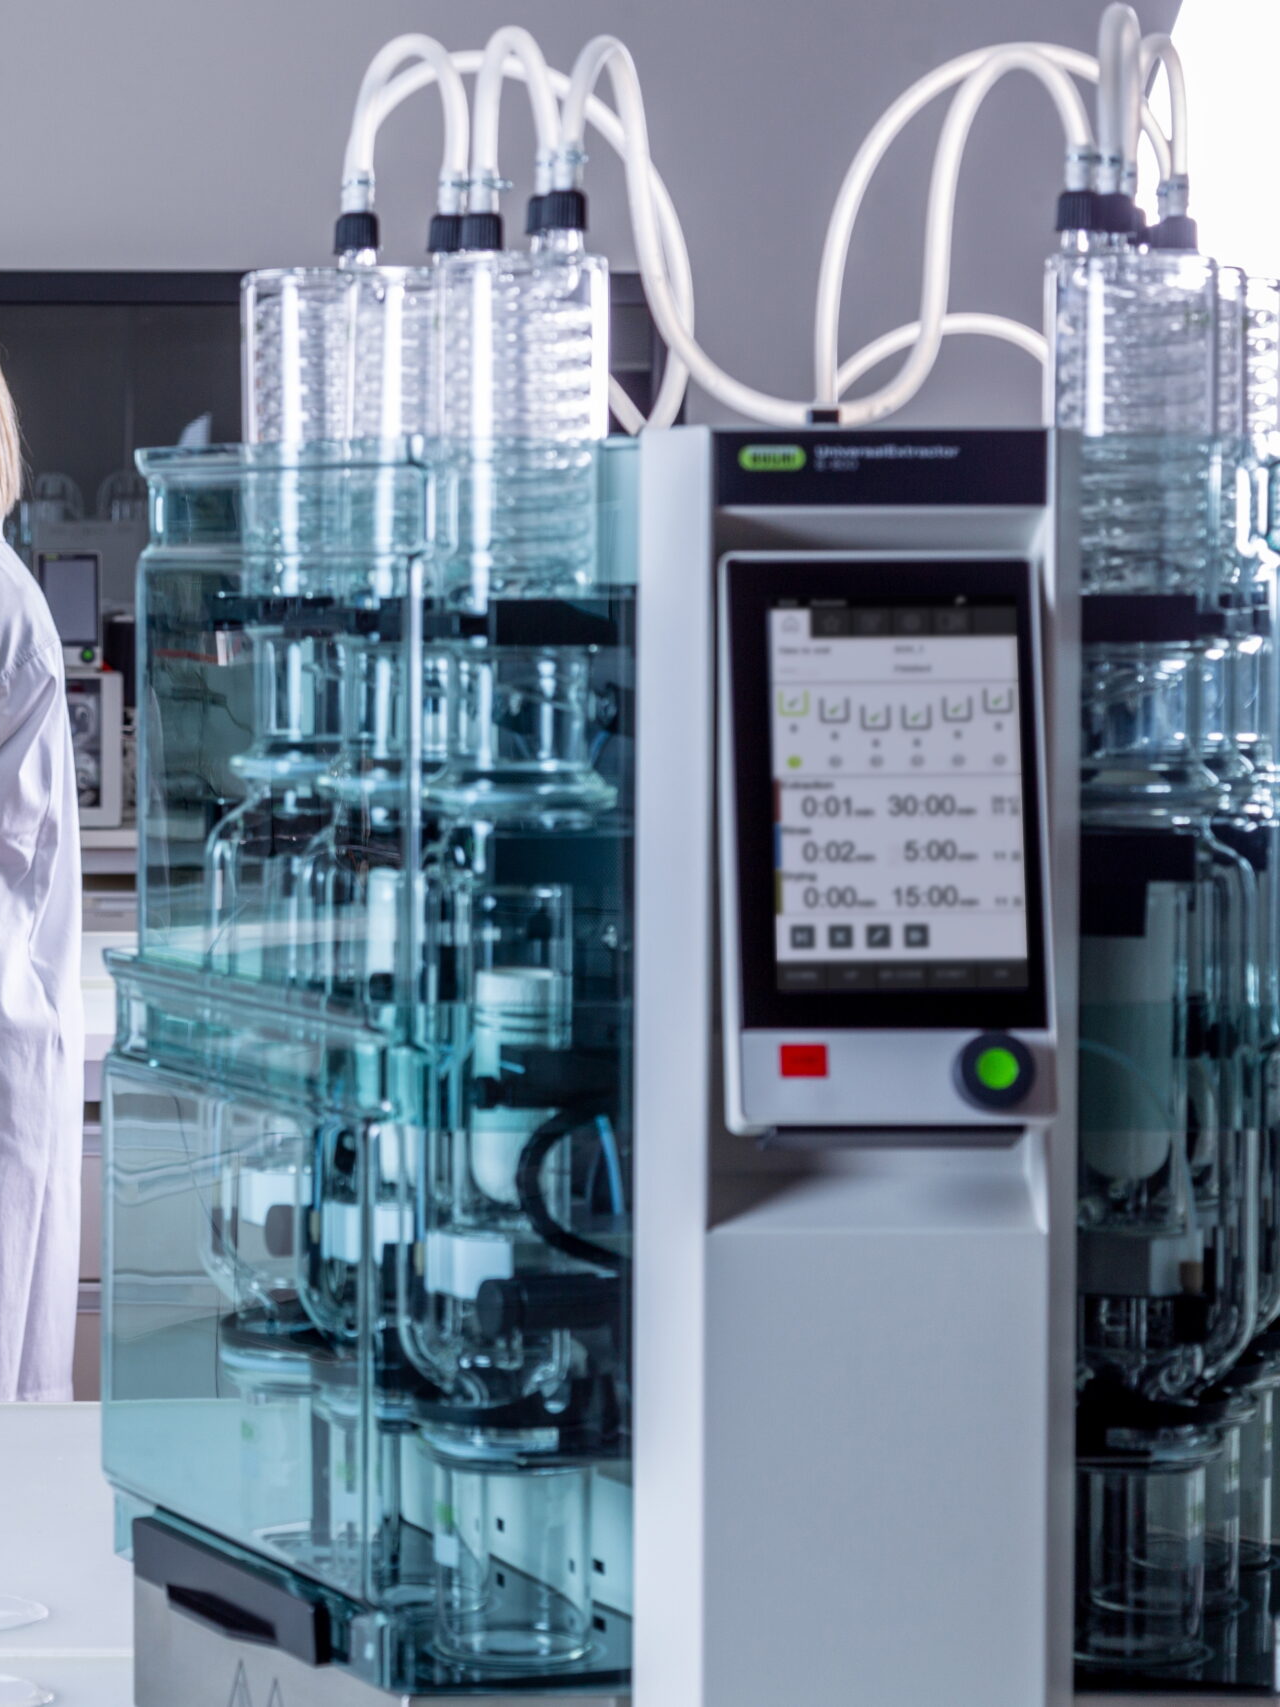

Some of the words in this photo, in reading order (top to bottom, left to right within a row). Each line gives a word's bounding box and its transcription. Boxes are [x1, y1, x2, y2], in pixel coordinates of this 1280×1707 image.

[801, 795, 853, 818] 0:01
[887, 794, 957, 817] 30:00
[802, 840, 855, 863] 0:02
[904, 839, 957, 862] 5:00
[803, 886, 857, 908] 0:00
[893, 885, 958, 907] 15:00
